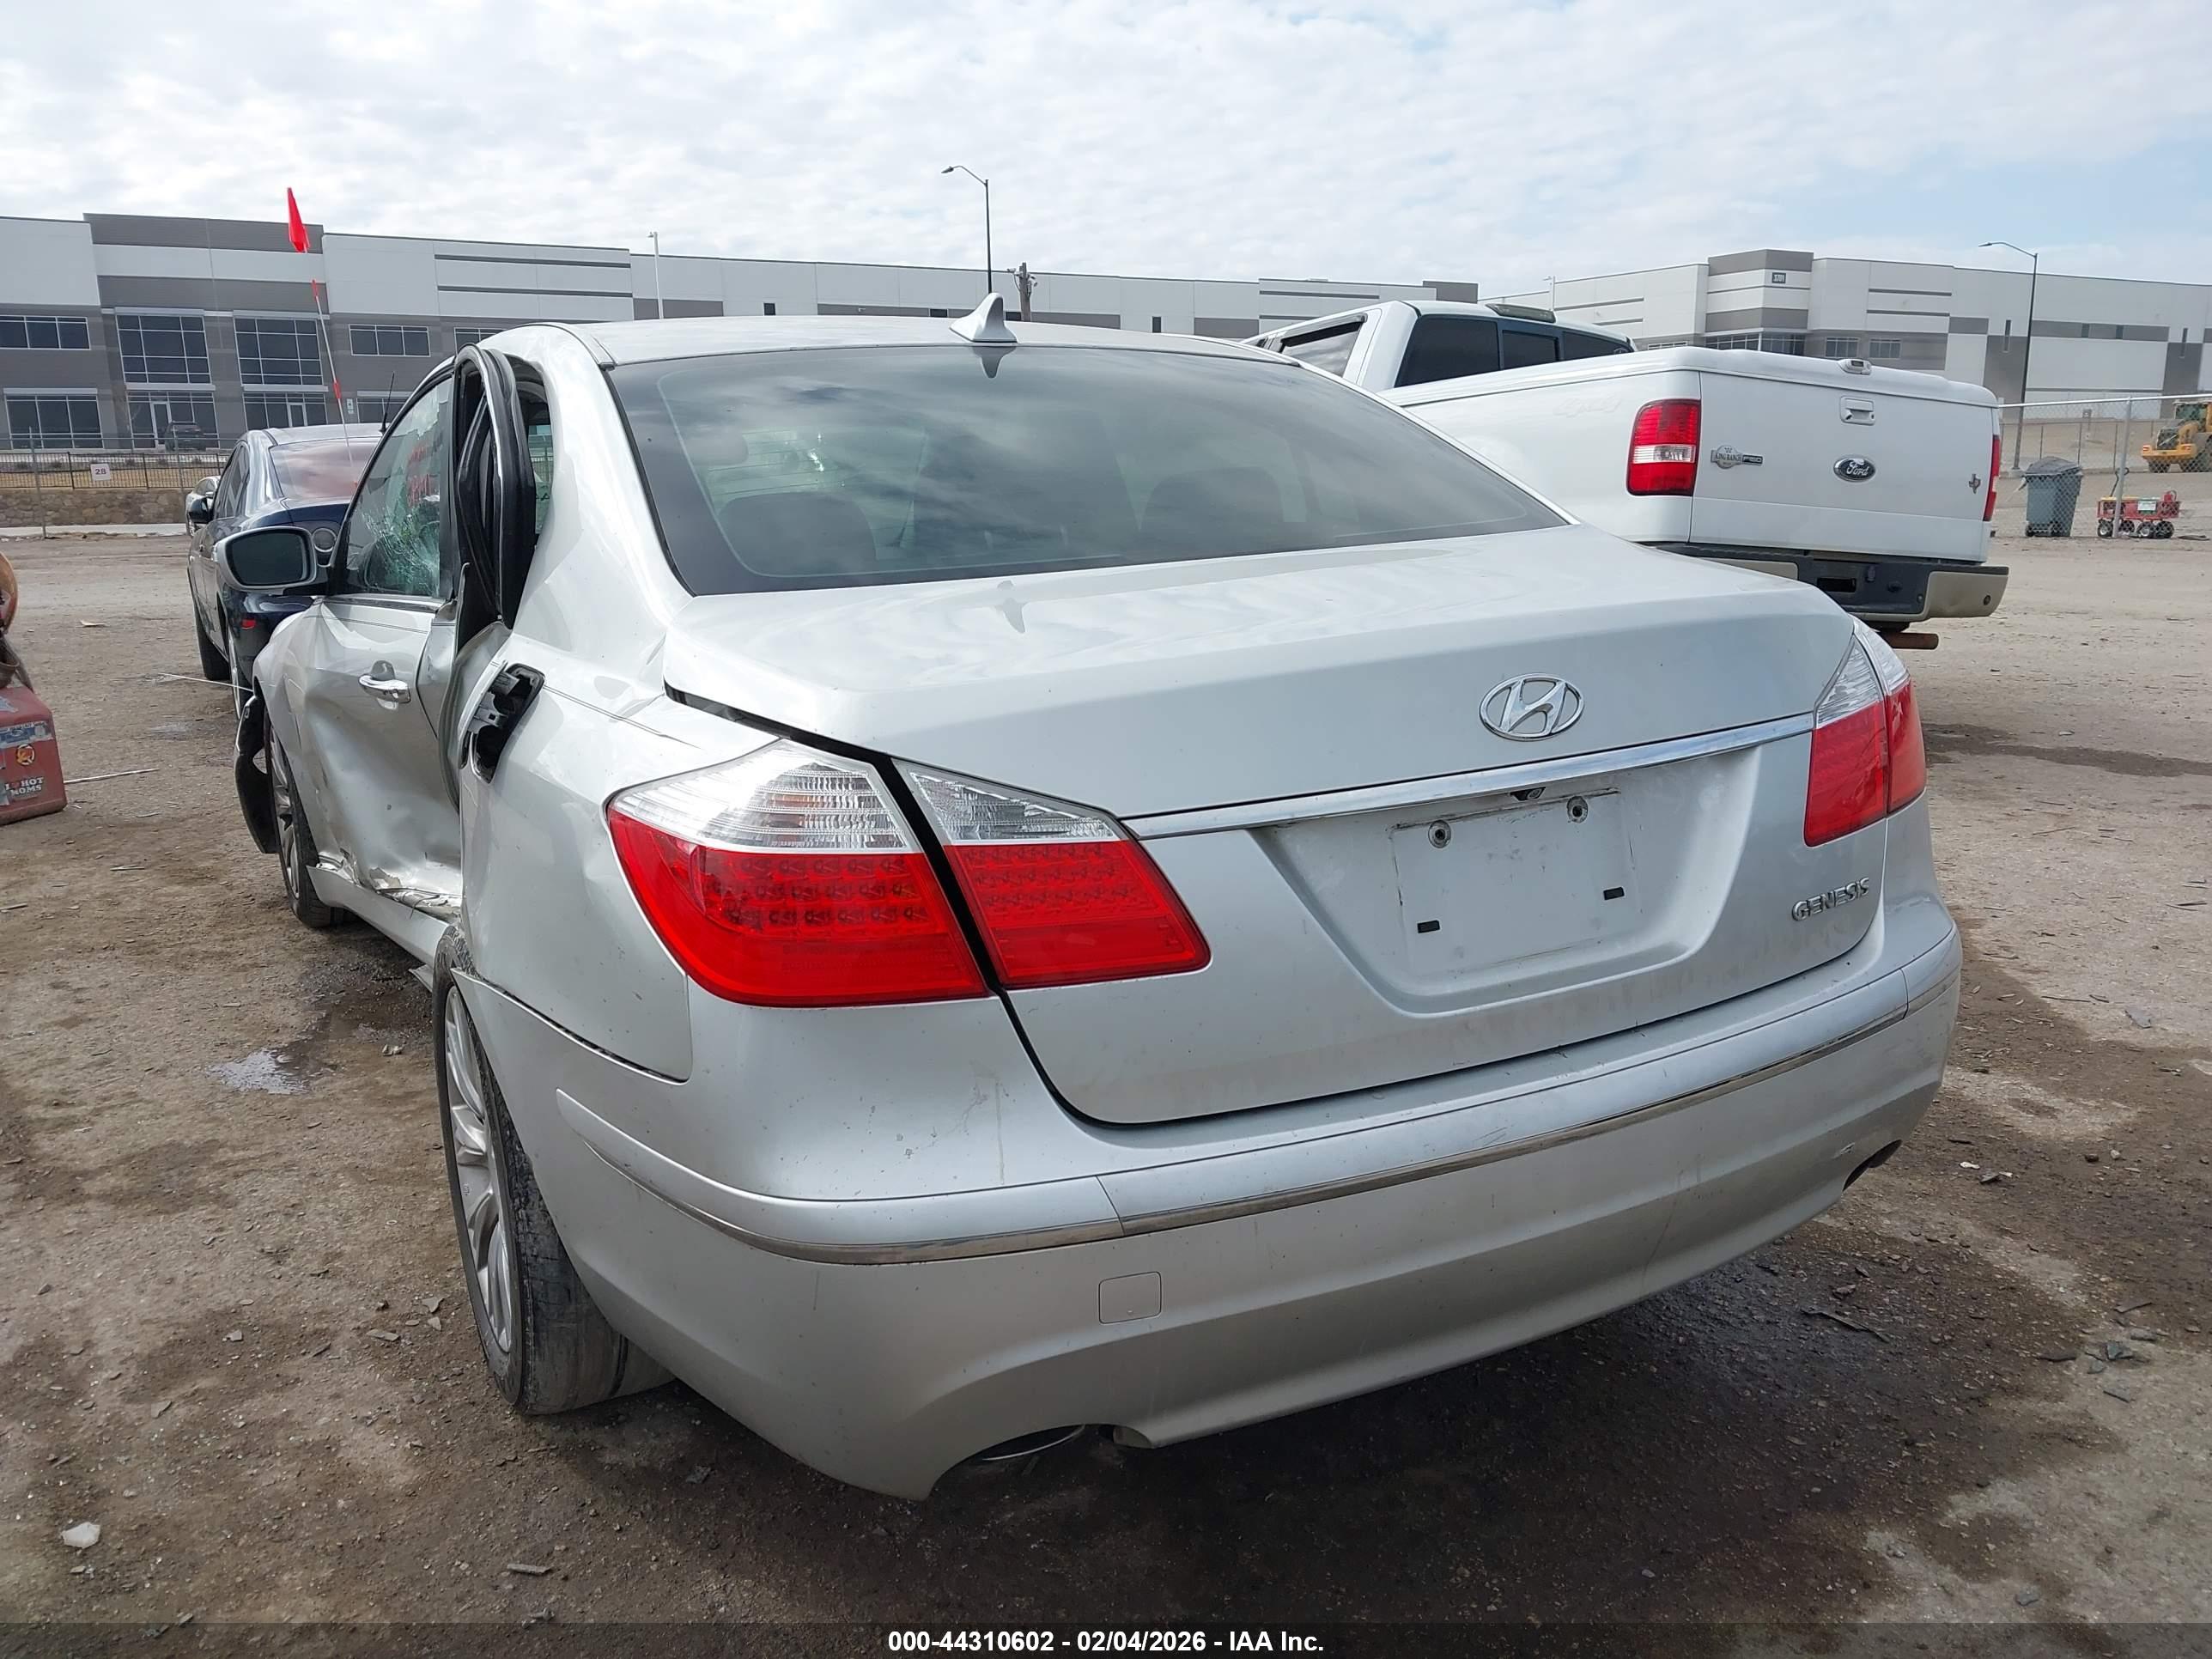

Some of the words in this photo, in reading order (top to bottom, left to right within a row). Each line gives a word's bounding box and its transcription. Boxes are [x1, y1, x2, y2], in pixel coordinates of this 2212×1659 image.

[1846, 460, 1869, 476] Ford
[21, 776, 44, 787] HOT
[10, 784, 42, 795] MOMS
[1792, 877, 1869, 921] GENESIS
